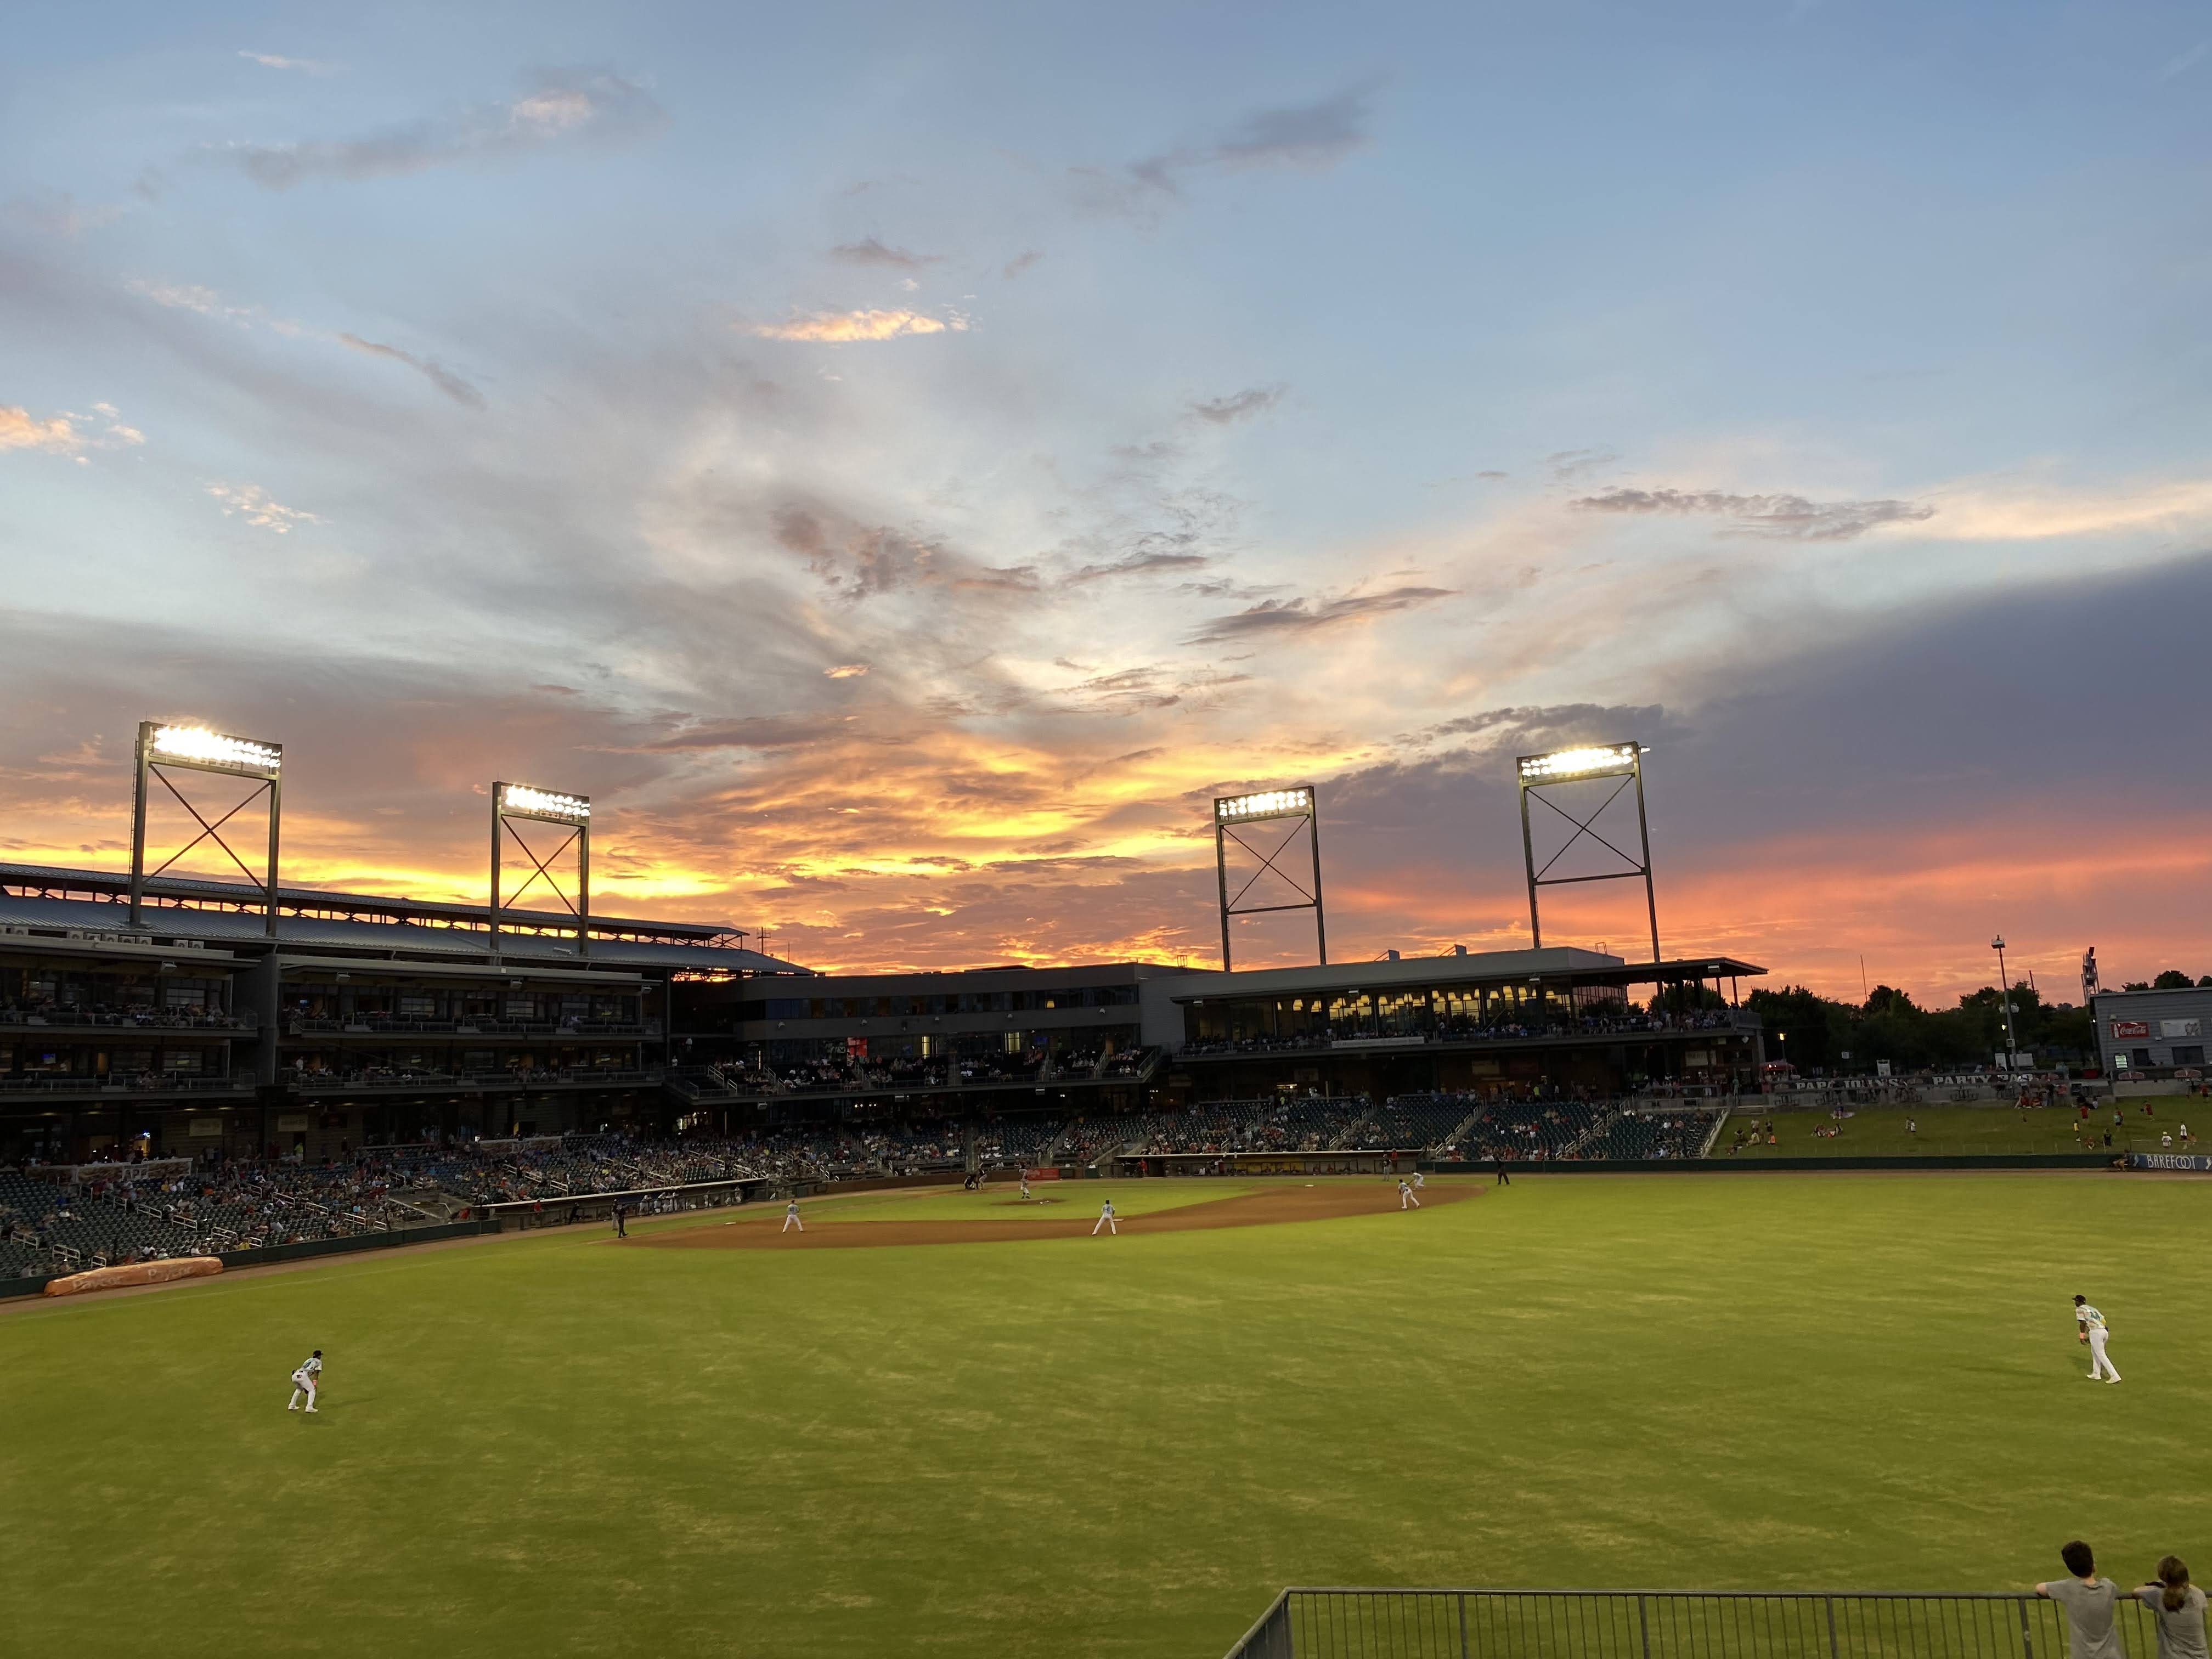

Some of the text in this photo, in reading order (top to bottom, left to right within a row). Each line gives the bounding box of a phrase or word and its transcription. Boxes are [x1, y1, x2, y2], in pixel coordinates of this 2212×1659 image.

[1932, 1075, 1992, 1085] PARTY
[2147, 1155, 2196, 1169] BAREFOOT
[148, 1267, 193, 1281] Pycor
